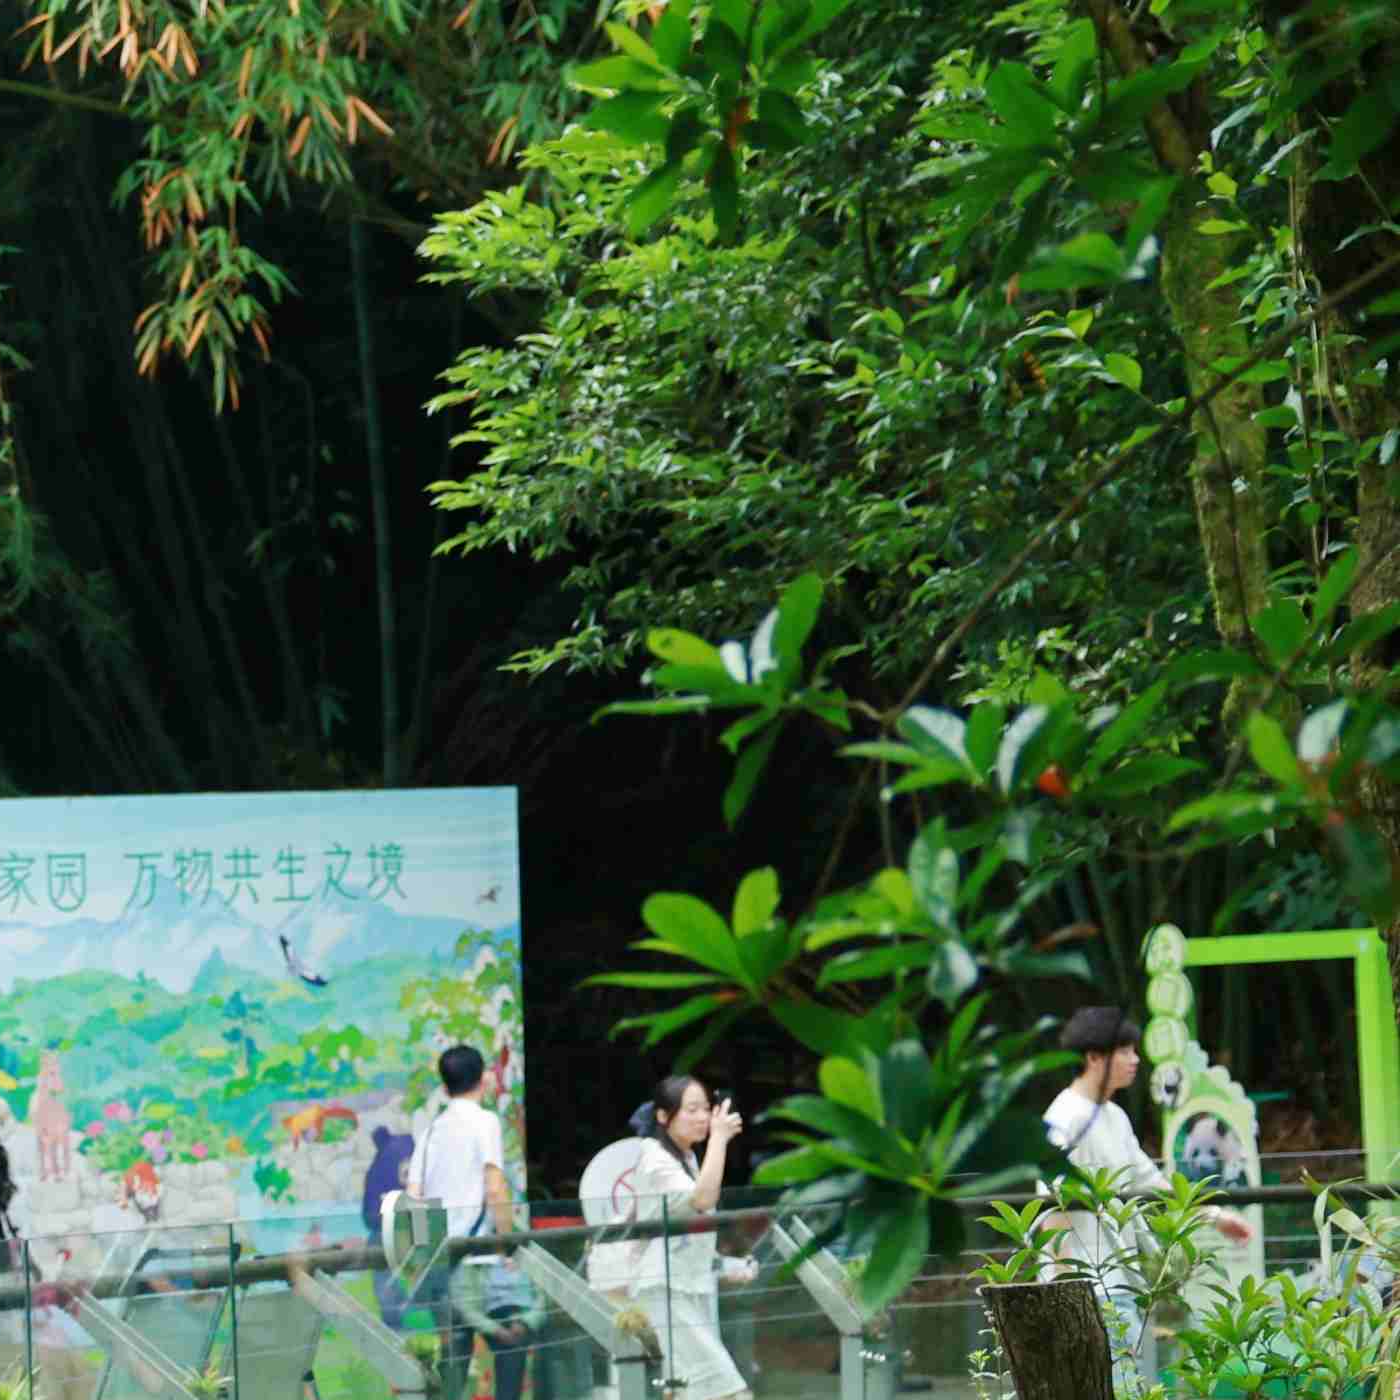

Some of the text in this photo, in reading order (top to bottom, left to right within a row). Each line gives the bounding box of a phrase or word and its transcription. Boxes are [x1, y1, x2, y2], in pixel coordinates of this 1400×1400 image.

[123, 842, 409, 909] 万物共生之境
